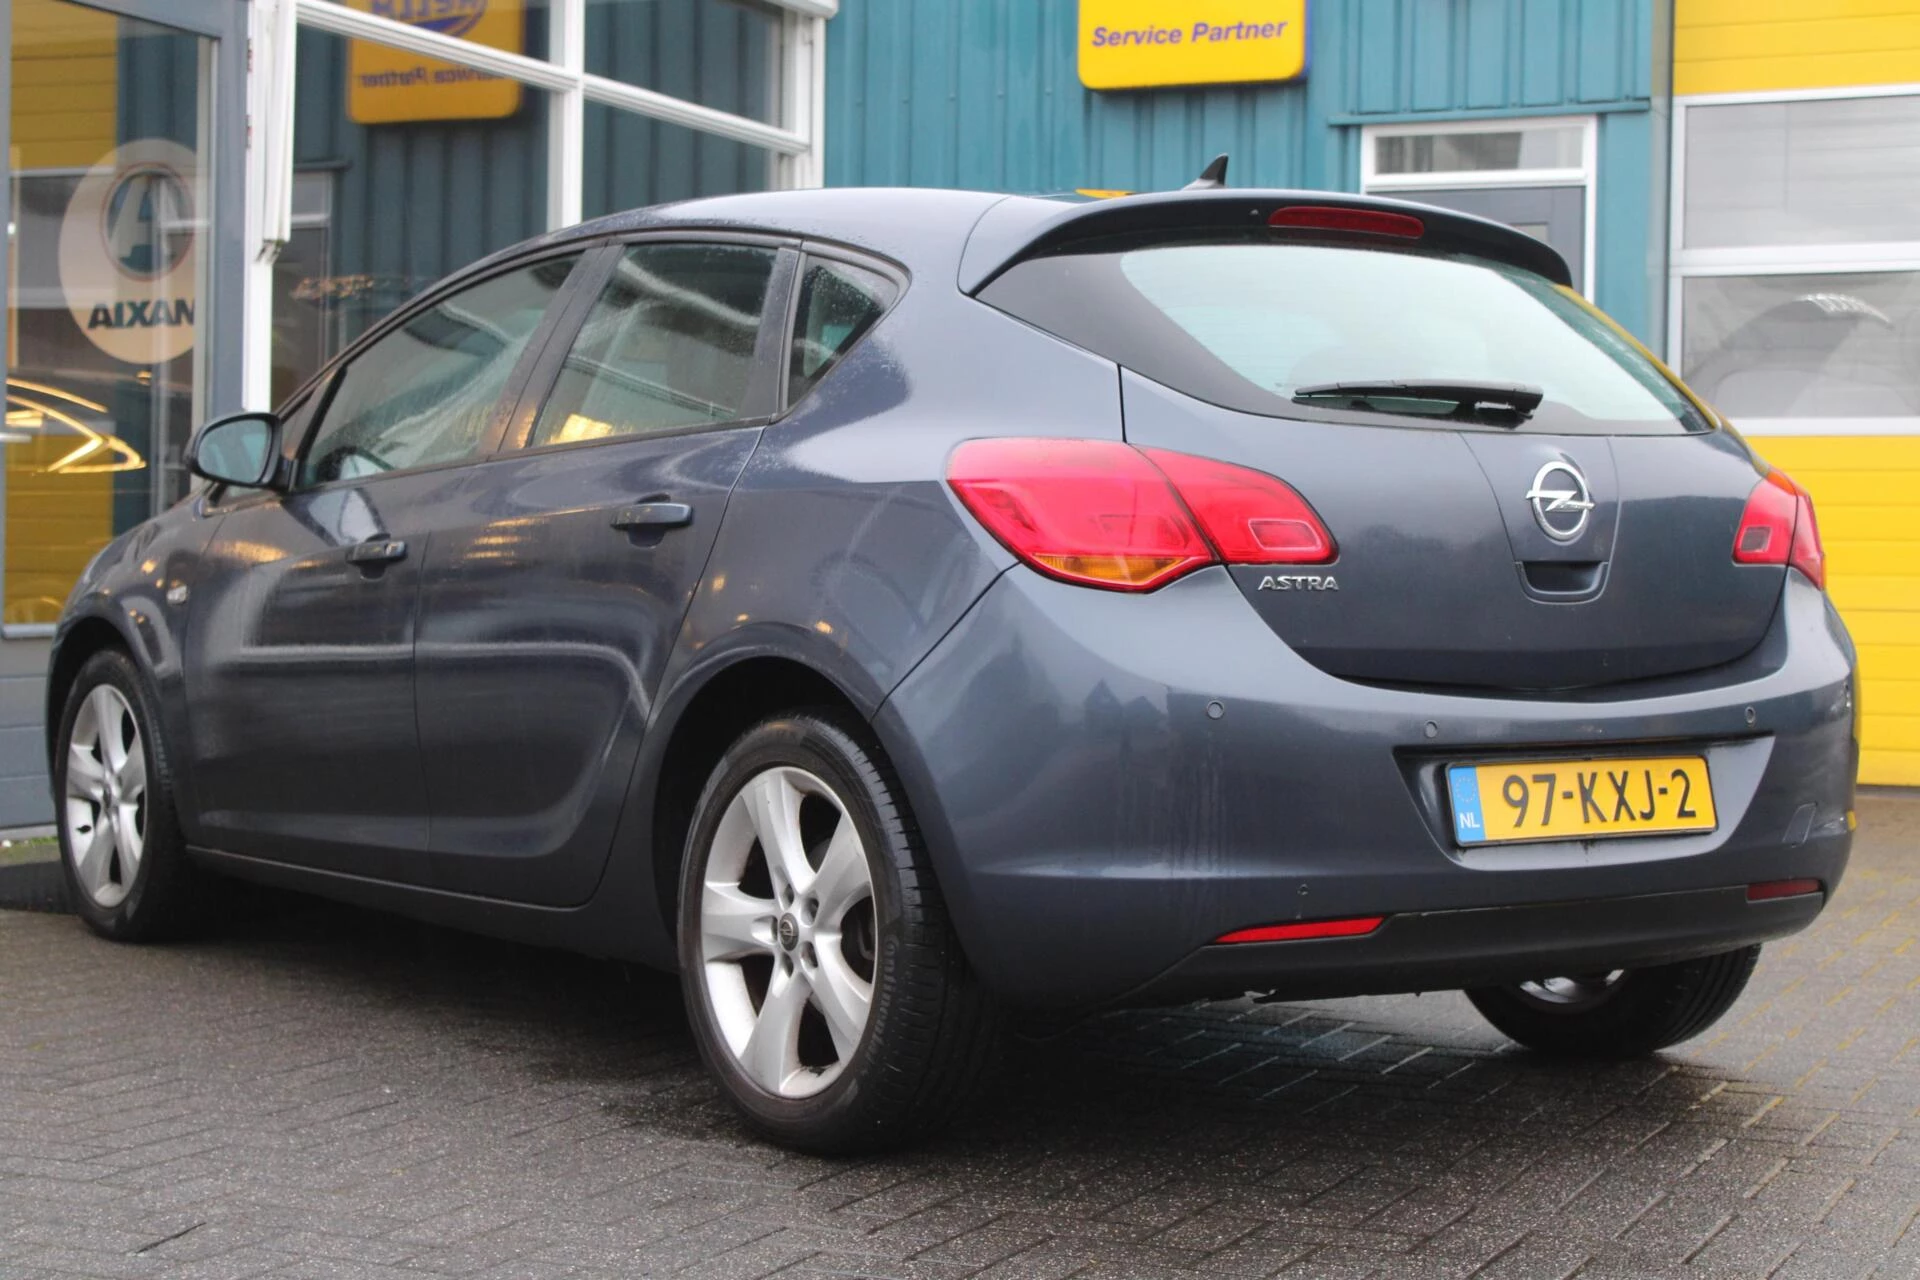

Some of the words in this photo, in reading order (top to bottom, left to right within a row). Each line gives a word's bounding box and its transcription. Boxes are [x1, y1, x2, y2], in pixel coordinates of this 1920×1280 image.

[1092, 25, 1183, 47] Service
[1191, 20, 1289, 43] Partner
[1258, 576, 1339, 591] ASTRA
[1502, 768, 1697, 828] 97-KXJ-2
[1459, 812, 1480, 829] NL
